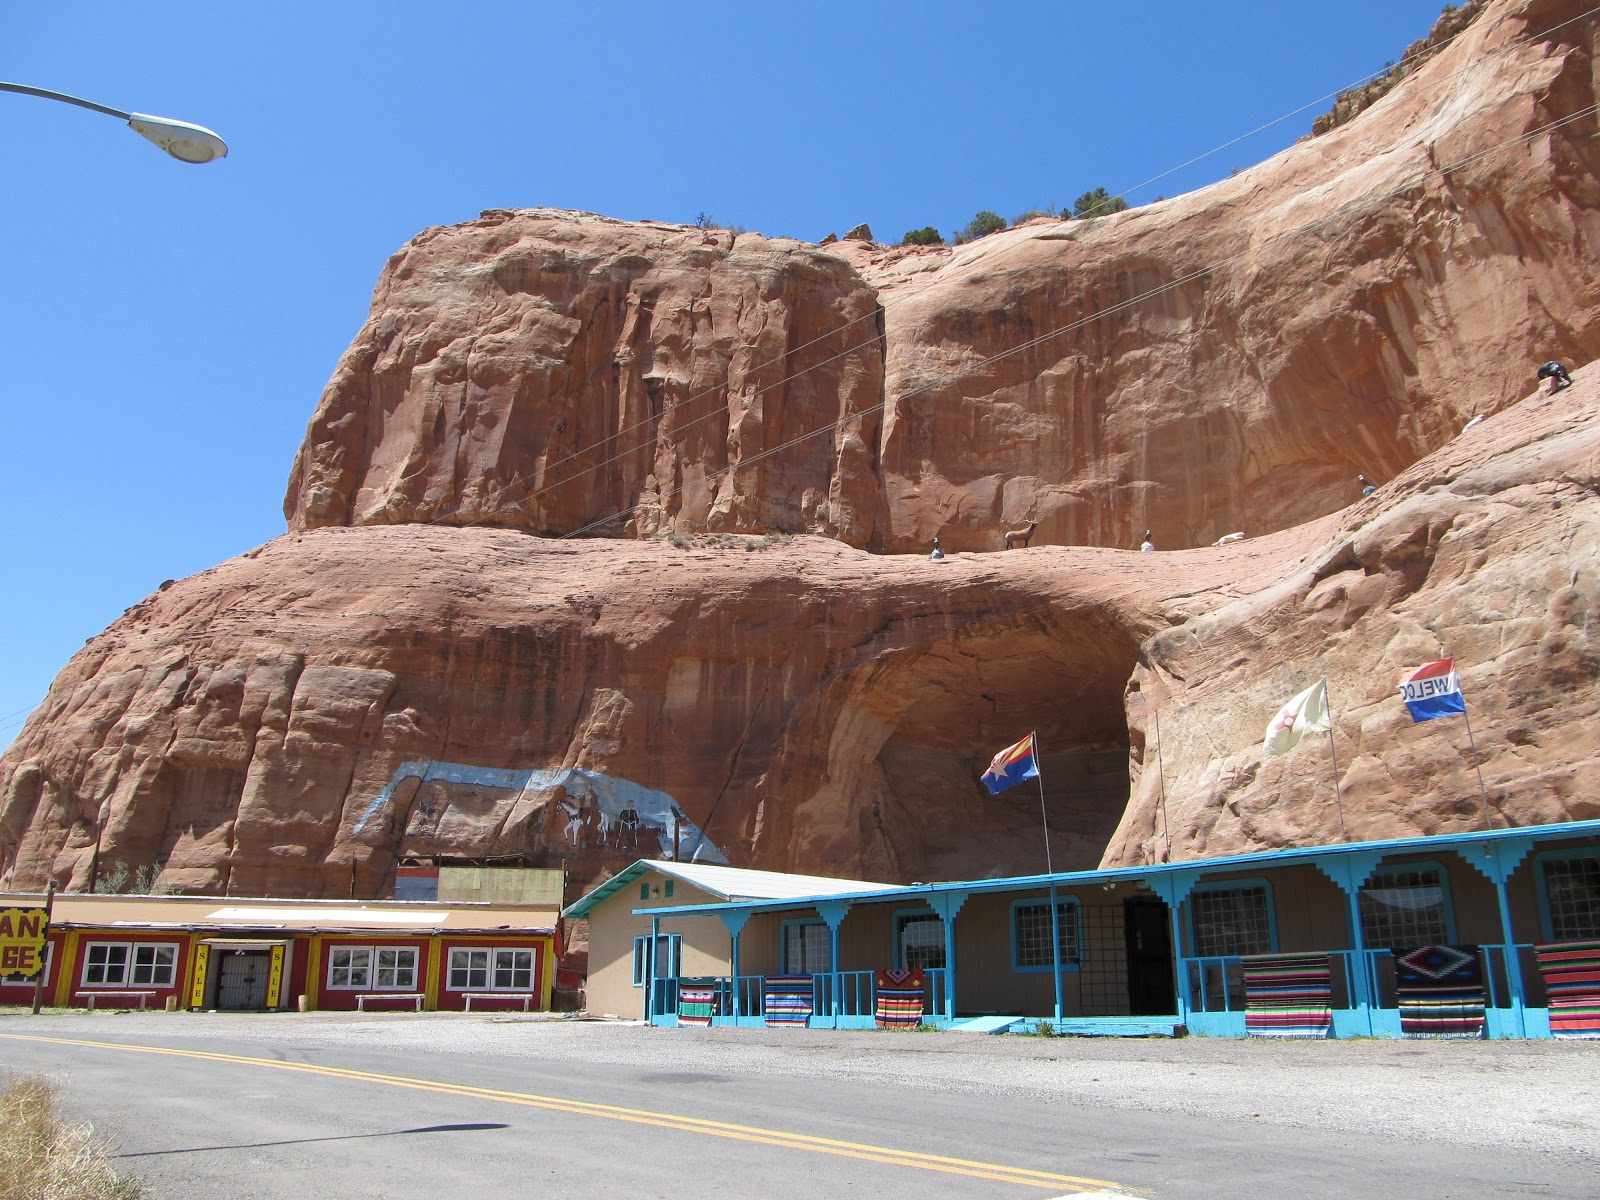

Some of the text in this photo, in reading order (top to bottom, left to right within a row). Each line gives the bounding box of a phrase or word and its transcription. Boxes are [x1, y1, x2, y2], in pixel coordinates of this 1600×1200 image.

[0, 915, 40, 938] AN
[2, 946, 35, 968] GE
[194, 952, 205, 997] SALE
[270, 953, 280, 997] SALE
